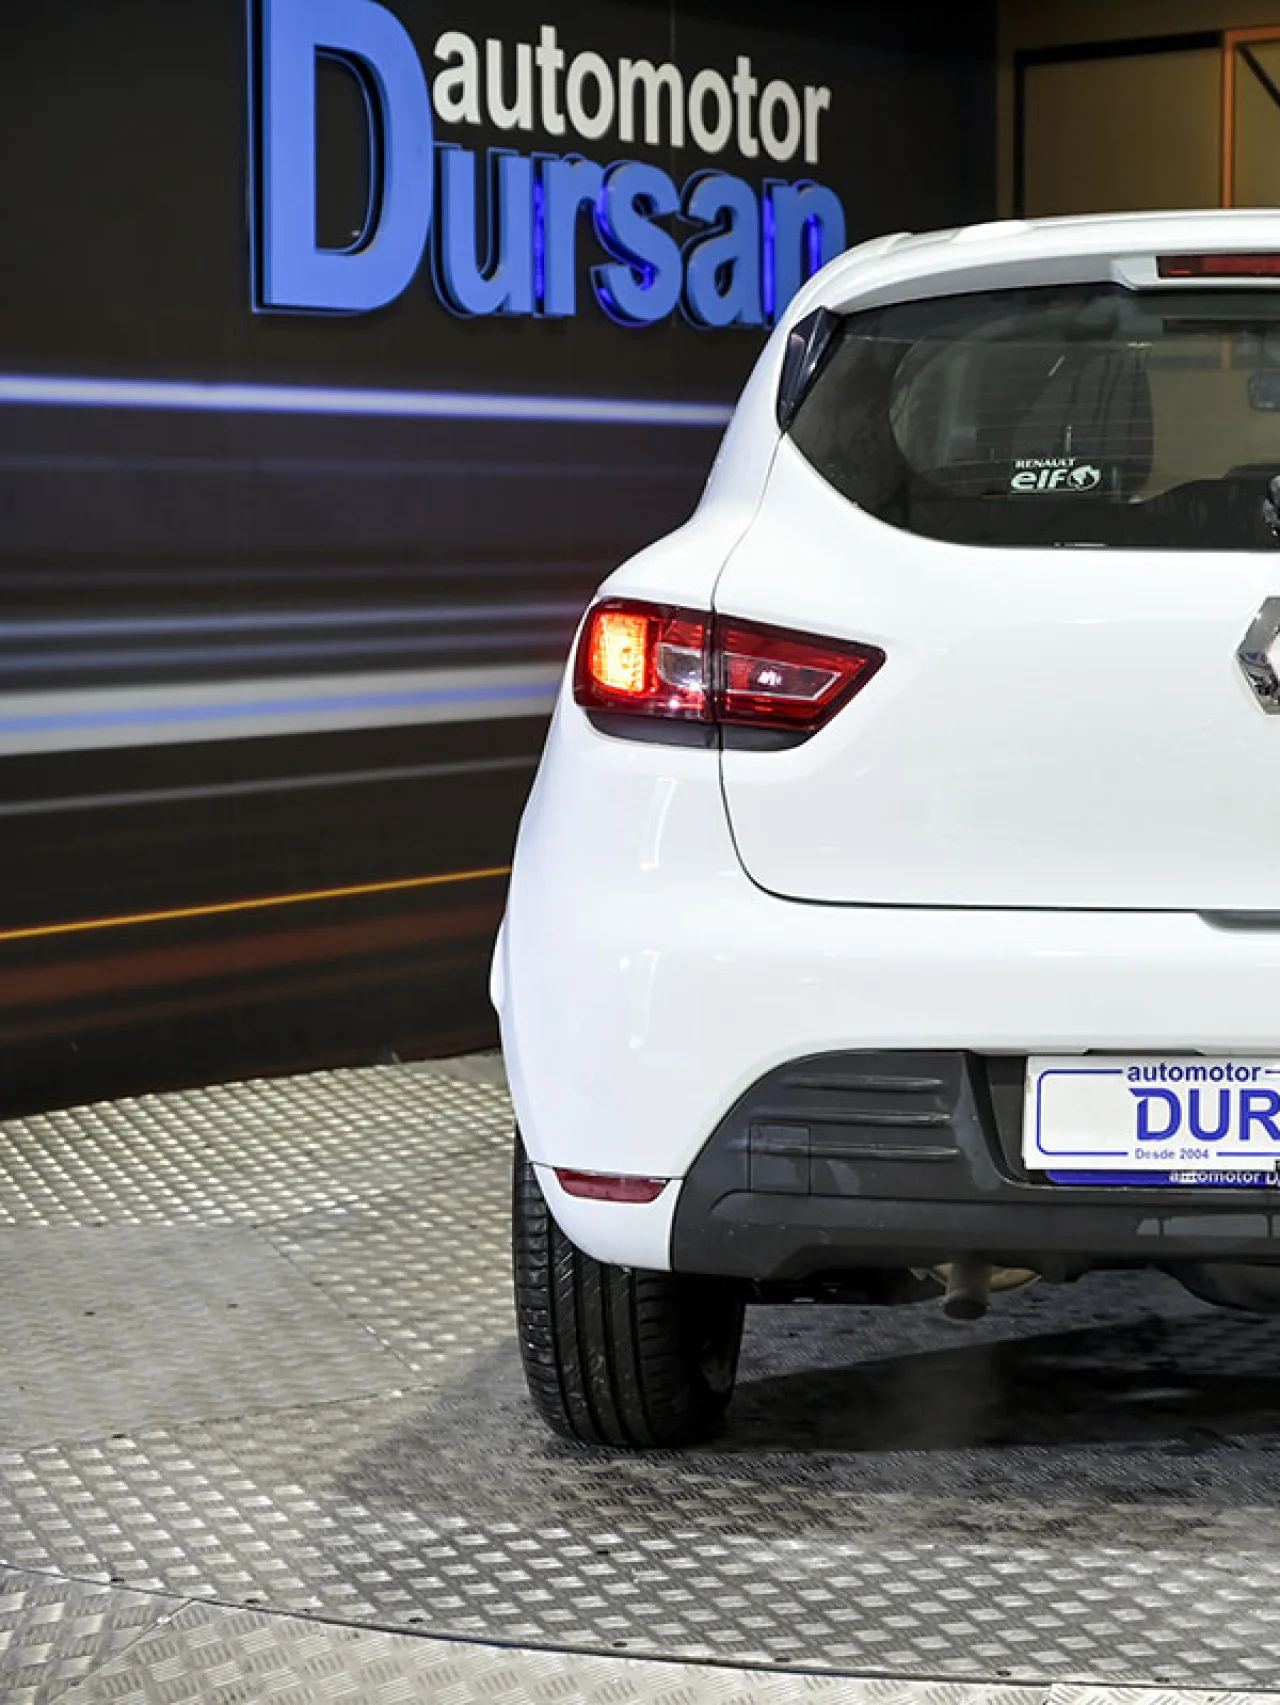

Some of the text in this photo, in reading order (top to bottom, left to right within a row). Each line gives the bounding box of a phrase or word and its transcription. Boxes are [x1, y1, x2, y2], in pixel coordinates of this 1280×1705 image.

[432, 24, 832, 164] automotor
[248, 0, 847, 328] Dursan
[1014, 458, 1076, 468] RENAULT
[1010, 468, 1068, 490] elf
[1127, 1062, 1262, 1083] automotor
[1134, 1147, 1210, 1160] Desde 2004
